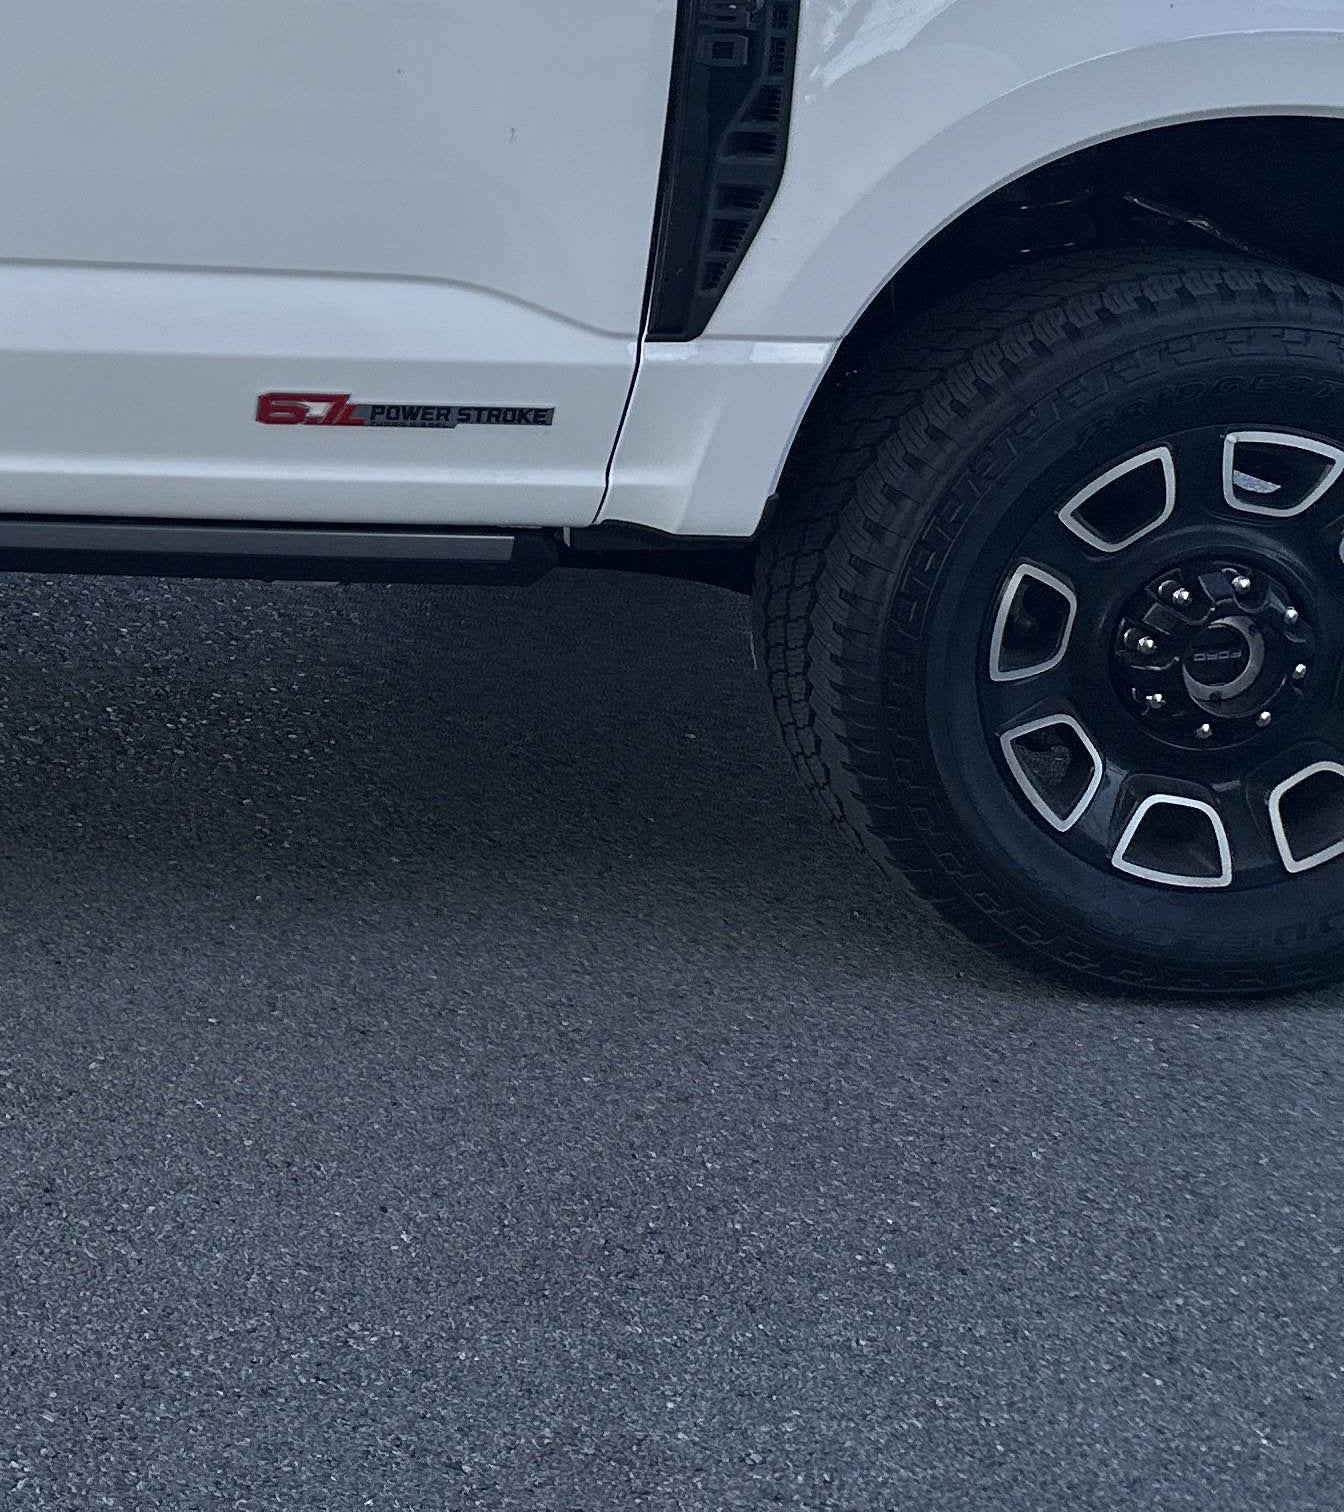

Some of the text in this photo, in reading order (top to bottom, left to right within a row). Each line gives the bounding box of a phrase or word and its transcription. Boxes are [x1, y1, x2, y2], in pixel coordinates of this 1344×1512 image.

[369, 404, 452, 422] POWER
[455, 406, 547, 424] STROKE
[1193, 648, 1243, 662] FORD
